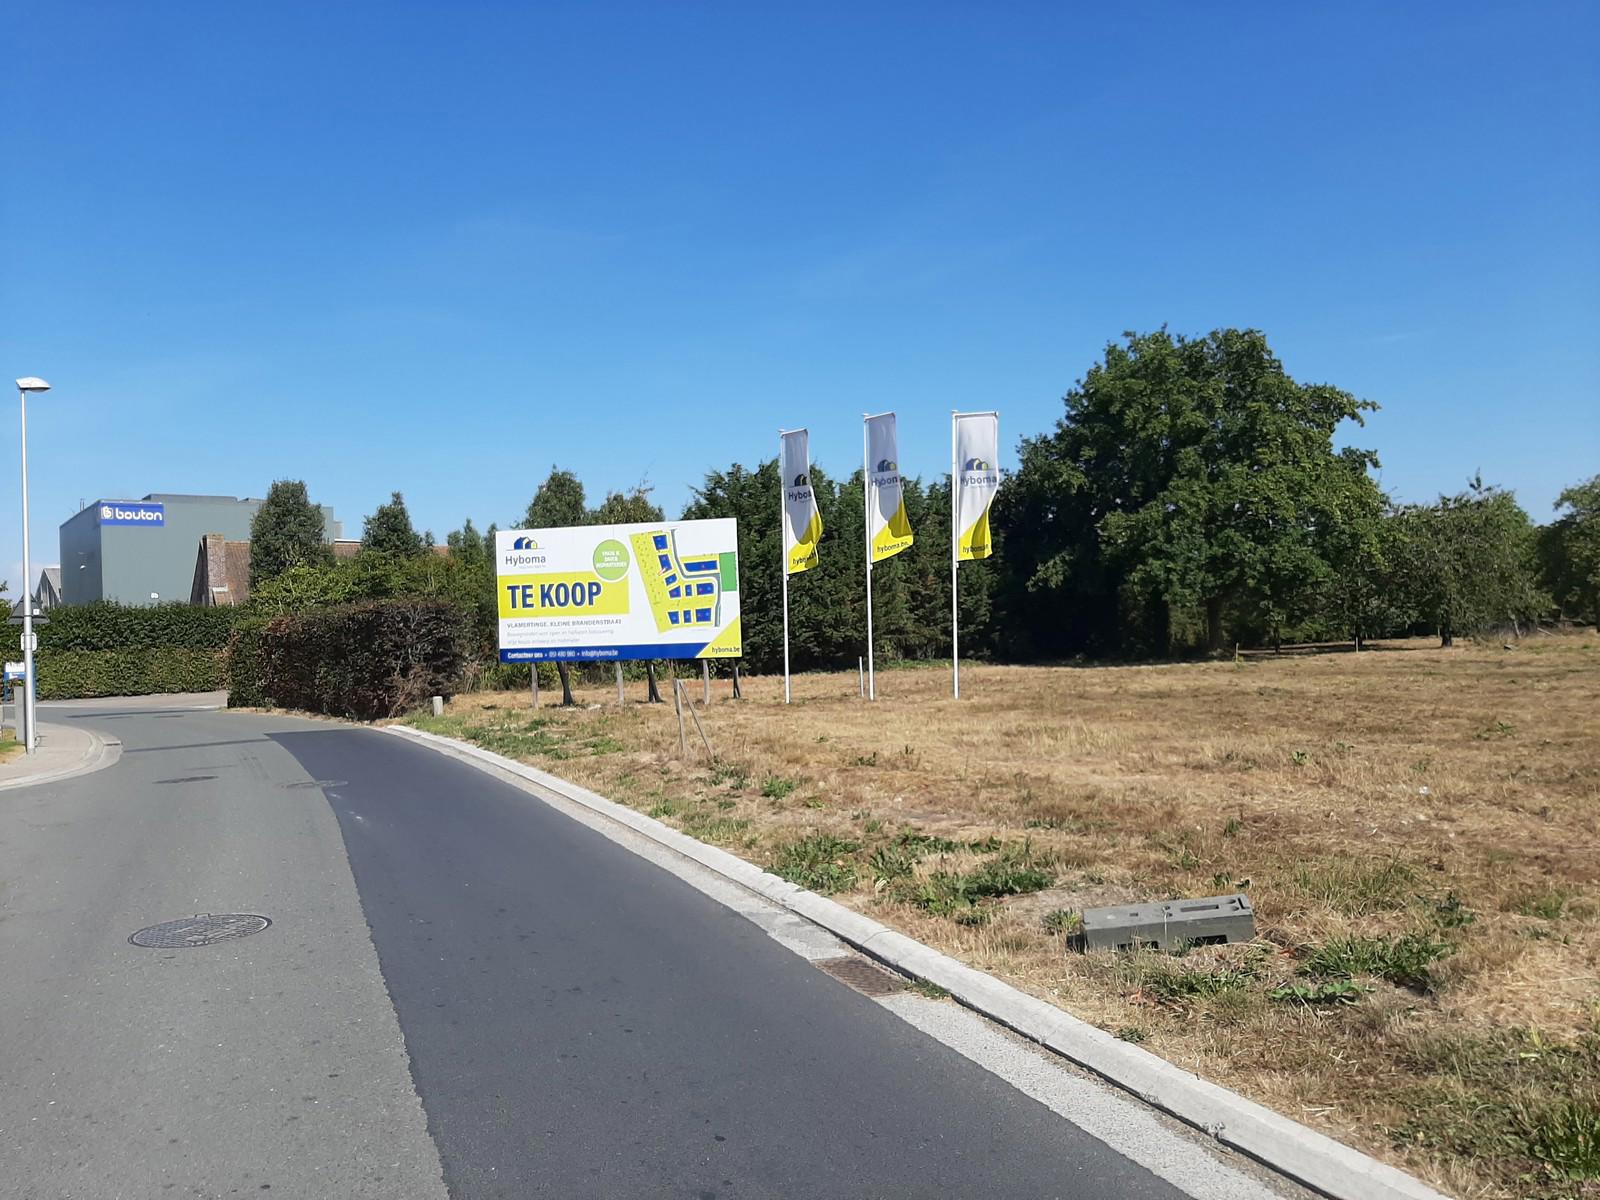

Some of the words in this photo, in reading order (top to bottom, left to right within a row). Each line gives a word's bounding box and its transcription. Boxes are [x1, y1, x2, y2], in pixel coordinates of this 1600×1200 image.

[960, 475, 997, 486] Hyboma
[115, 507, 163, 521] bouton
[505, 555, 546, 567] Hyboma
[507, 584, 534, 609] TE
[540, 581, 602, 608] KOOP
[711, 646, 740, 655] hyboma.be
